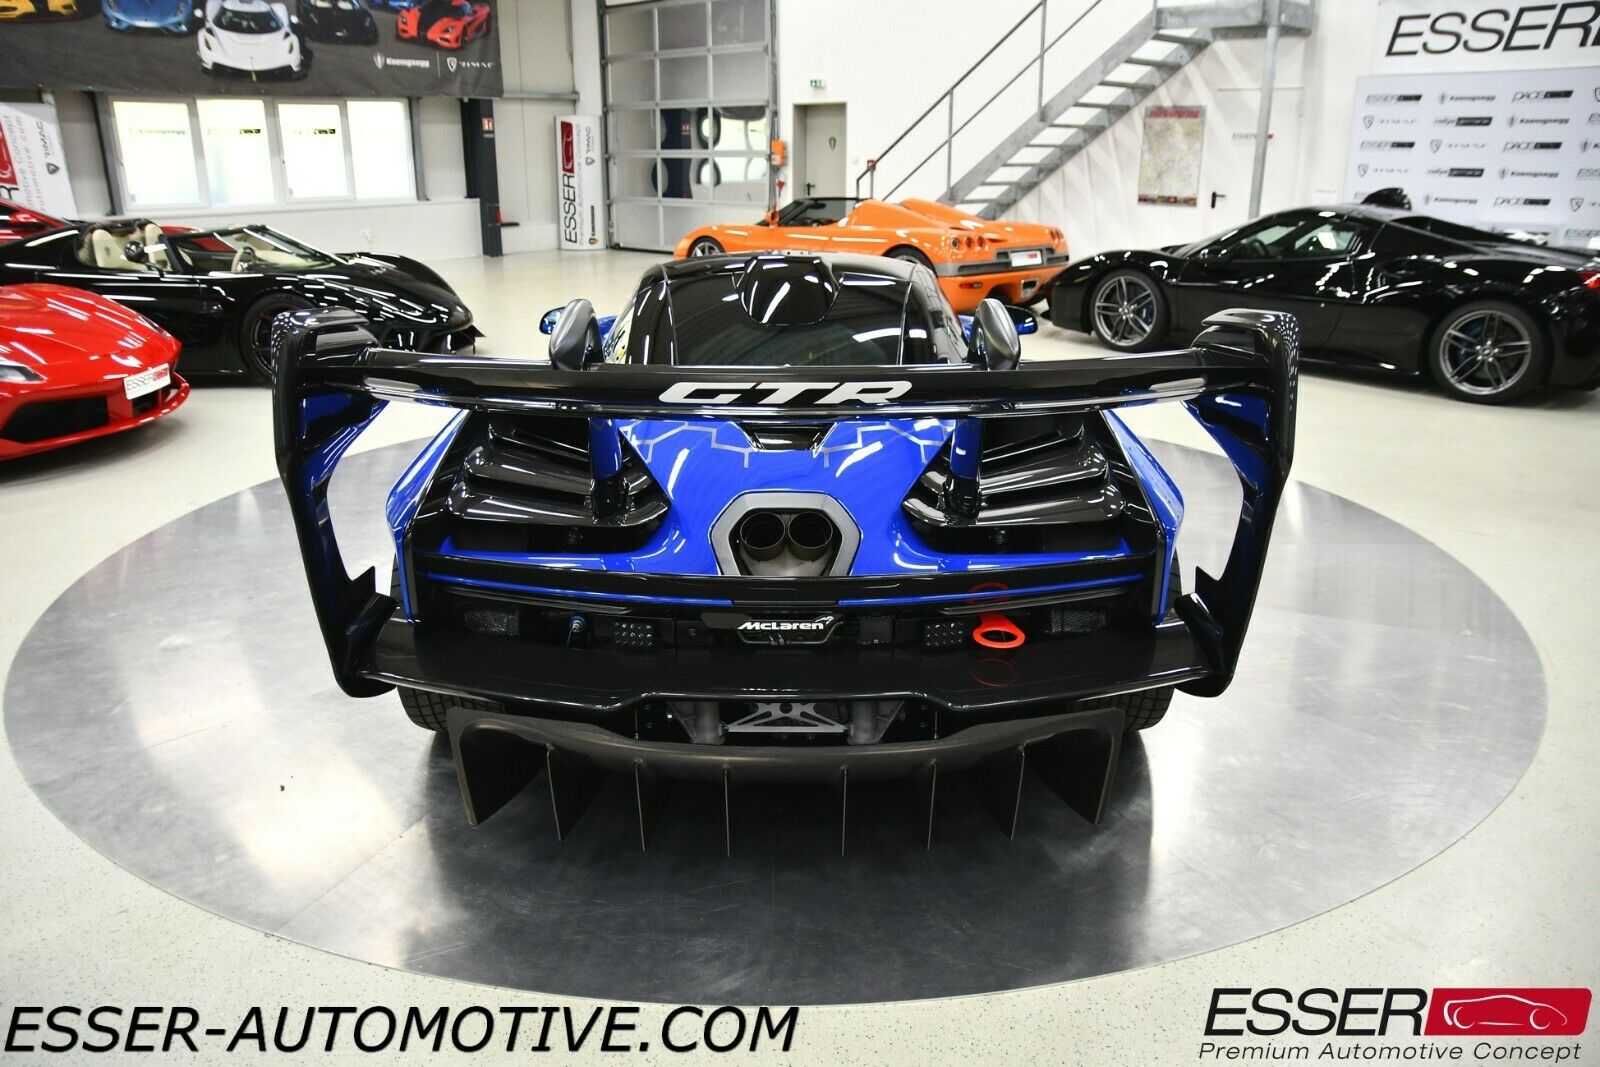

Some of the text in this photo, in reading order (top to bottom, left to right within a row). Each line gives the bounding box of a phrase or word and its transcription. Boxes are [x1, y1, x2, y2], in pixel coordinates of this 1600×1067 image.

[1385, 1, 1598, 57] ESSER
[562, 173, 578, 243] ESSER
[659, 380, 912, 404] GTR
[738, 620, 825, 631] McLaren
